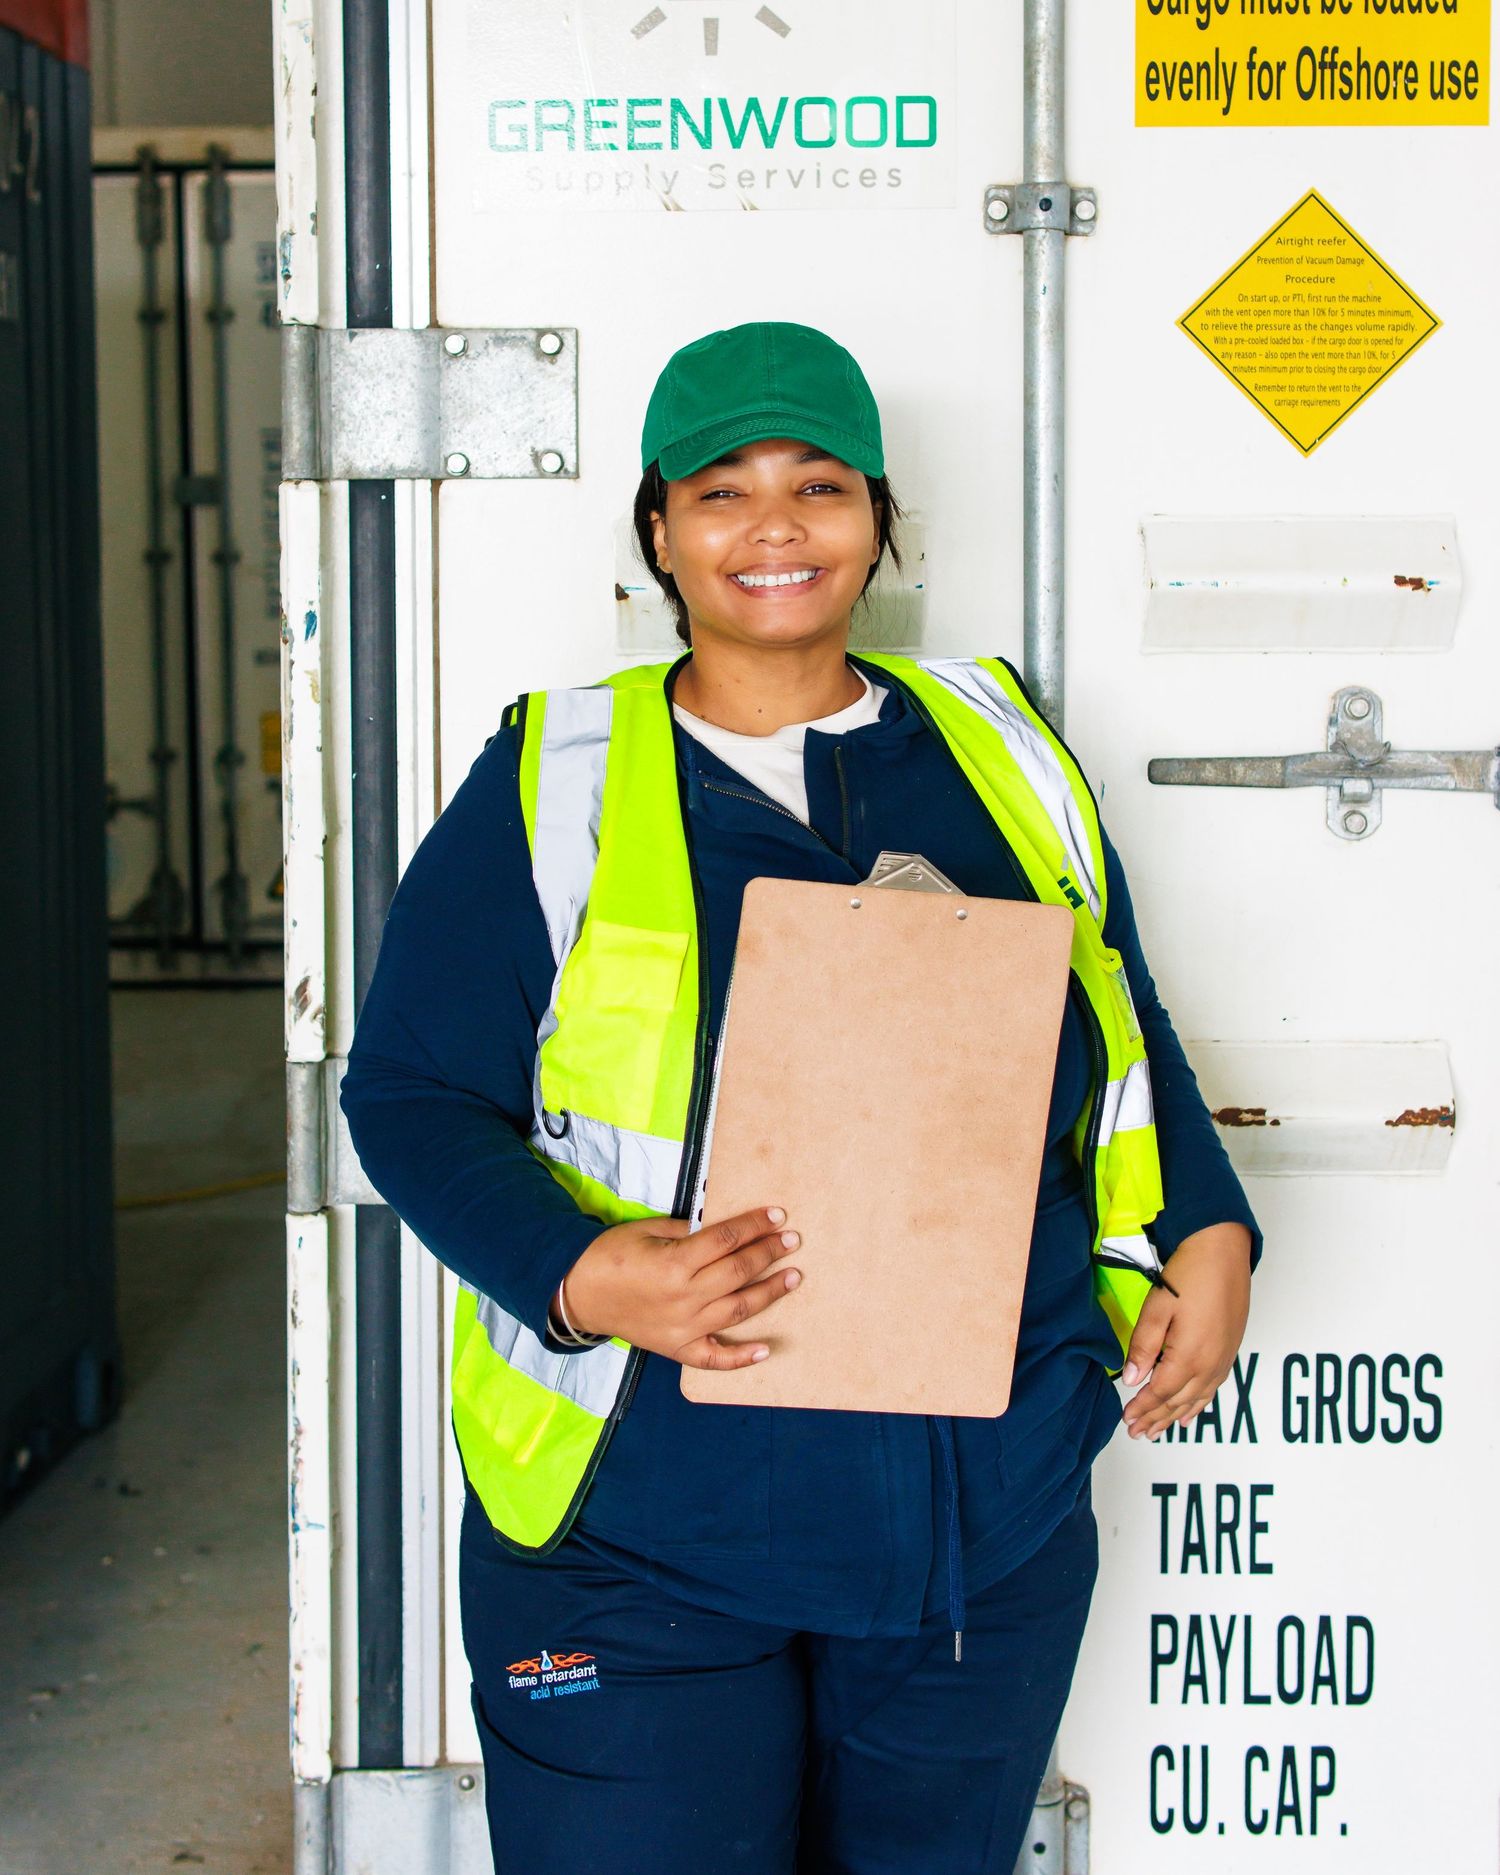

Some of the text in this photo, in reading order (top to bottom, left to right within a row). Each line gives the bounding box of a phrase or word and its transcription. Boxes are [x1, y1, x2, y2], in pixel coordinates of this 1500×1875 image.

[1145, 45, 1479, 116] evenly for Offshore use
[487, 95, 938, 152] GREENWOOD
[525, 162, 903, 196] Supply Services
[1276, 237, 1347, 247] Airtight reefer
[1256, 256, 1365, 266] Prevention of Vacuum Damage
[1285, 275, 1336, 284] Procedure
[1238, 294, 1249, 302] On
[1250, 294, 1266, 302] start
[1269, 295, 1280, 304] up,
[1292, 294, 1305, 303] PTI,
[1307, 294, 1322, 302] first
[1338, 294, 1350, 302] the
[1351, 294, 1381, 302] machine
[1205, 308, 1220, 316] with
[1222, 308, 1234, 316] the
[1253, 310, 1271, 318] open
[1293, 308, 1310, 316] than
[1312, 308, 1326, 316] 10%
[1328, 308, 1338, 316] for
[1340, 308, 1345, 316] 5
[1347, 308, 1376, 316] minutes
[1377, 308, 1414, 318] minimum,
[1212, 322, 1238, 331] relieve
[1240, 322, 1253, 331] the
[1256, 324, 1291, 332] pressure
[1304, 322, 1318, 331] the
[1320, 322, 1353, 332] changes
[1356, 322, 1385, 331] volume
[1388, 322, 1417, 332] rapidly.
[1213, 336, 1228, 345] With
[1234, 336, 1268, 346] pre-cooled
[1270, 336, 1291, 345] loaded
[1292, 336, 1304, 345] box
[1311, 336, 1316, 345] if
[1317, 336, 1327, 345] the
[1328, 338, 1346, 347] cargo
[1347, 336, 1362, 345] door
[1364, 336, 1369, 345] is
[1370, 336, 1394, 346] opened
[1395, 337, 1404, 345] for
[1221, 352, 1233, 360] any
[1264, 350, 1278, 359] also
[1280, 352, 1296, 360] open
[1298, 350, 1309, 359] the
[1346, 350, 1361, 359] than
[1364, 351, 1378, 360] 10%,
[1379, 350, 1389, 359] for
[1391, 350, 1396, 359] 5
[1232, 365, 1257, 373] minutes
[1258, 365, 1287, 373] minimum
[1289, 365, 1304, 374] prior
[1314, 365, 1336, 374] closing
[1337, 365, 1347, 373] the
[1349, 366, 1367, 375] cargo
[1368, 365, 1384, 374] door.
[1254, 383, 1287, 392] Remember
[1317, 383, 1327, 392] the
[1351, 383, 1362, 392] the
[1274, 398, 1341, 407] carriage requirements
[1152, 1352, 1444, 1444] AX GROSS
[1151, 1483, 1275, 1575] TARE
[1150, 1614, 1375, 1705] PAYLOAD
[508, 1663, 597, 1689] flame retardant
[530, 1677, 601, 1700] acid resistant
[1150, 1744, 1348, 1836] CU. CAP.
